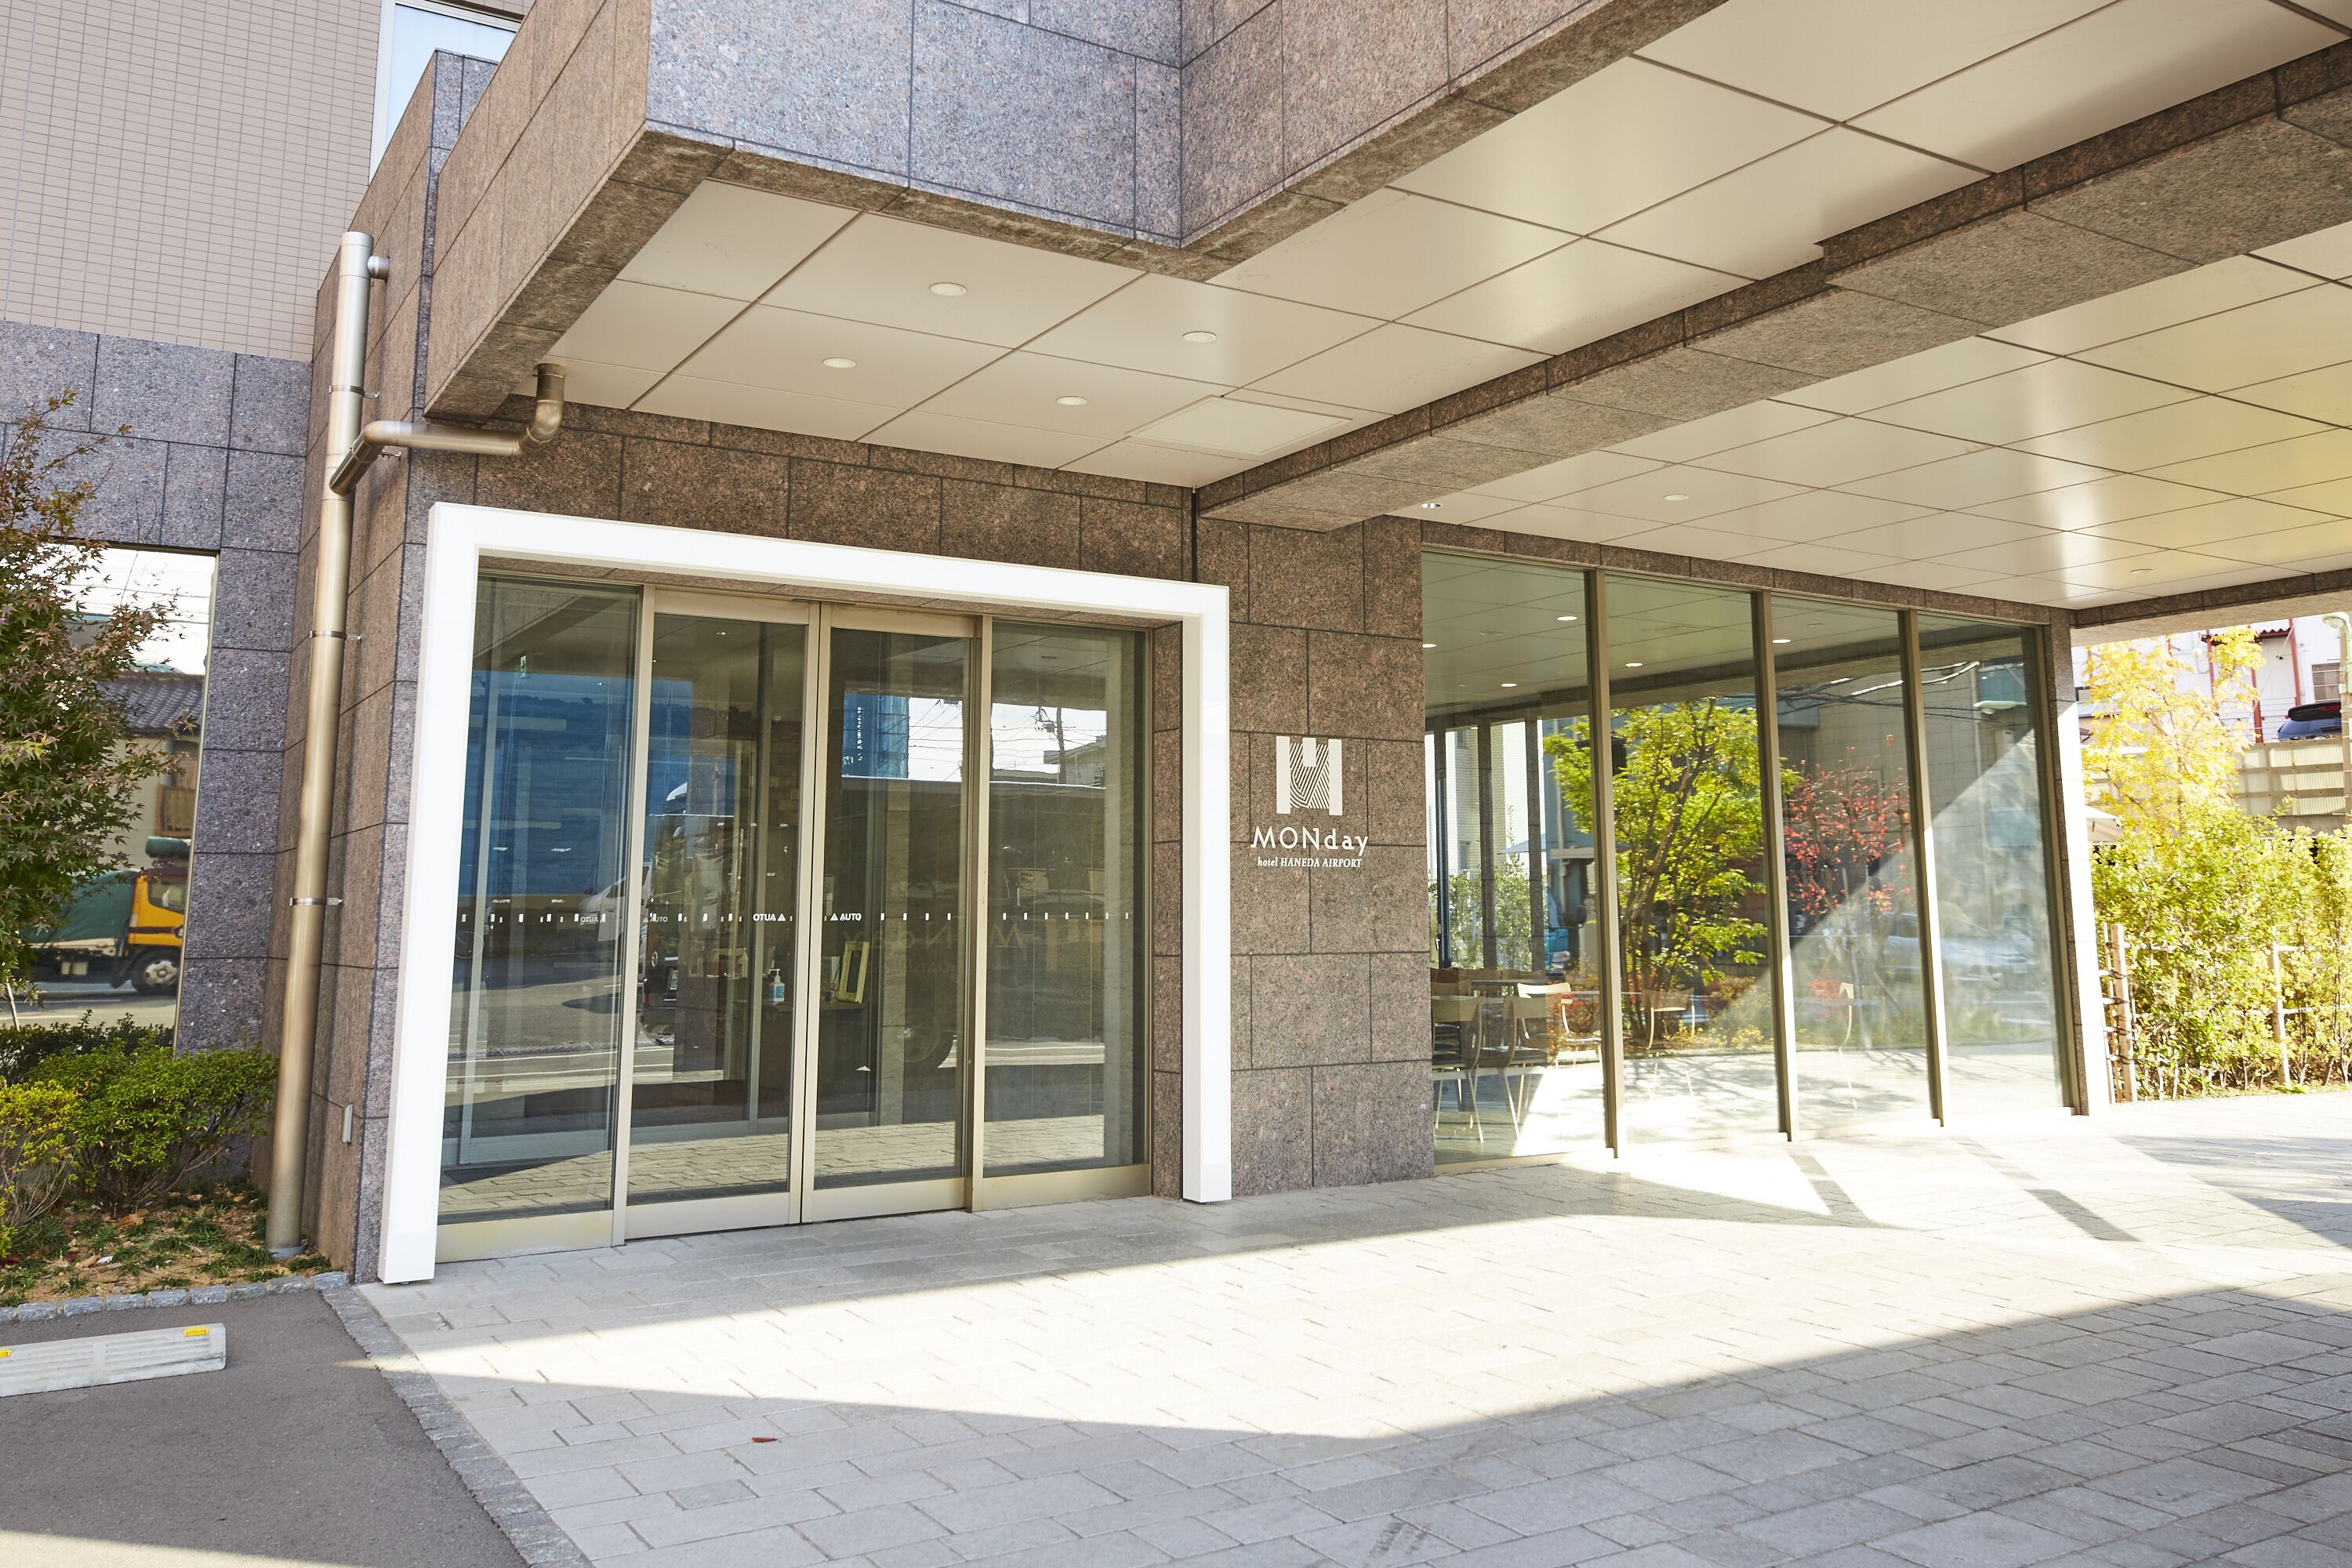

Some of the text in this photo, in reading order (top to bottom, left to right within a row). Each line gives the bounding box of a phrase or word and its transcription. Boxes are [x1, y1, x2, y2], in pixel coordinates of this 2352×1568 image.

[1250, 826, 1369, 856] MONday
[1257, 855, 1363, 867] hotel HANEDA AIRPORT
[840, 913, 862, 921] AUTO
